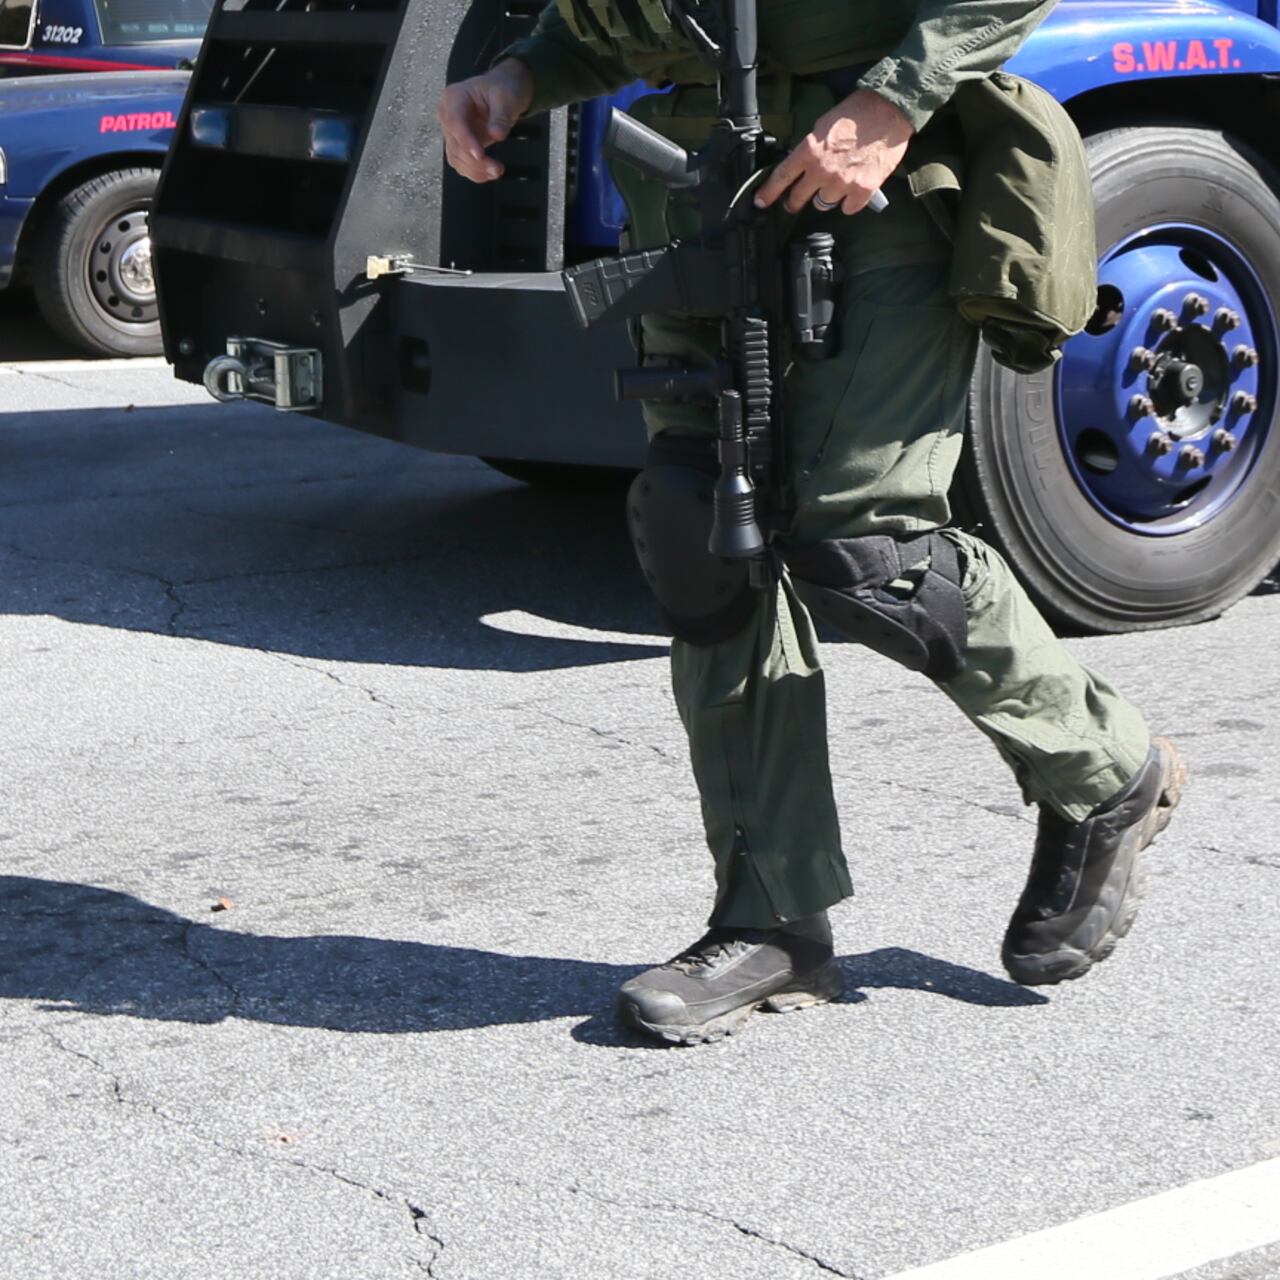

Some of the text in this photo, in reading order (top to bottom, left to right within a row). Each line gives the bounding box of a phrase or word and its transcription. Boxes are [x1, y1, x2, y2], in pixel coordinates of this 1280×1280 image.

[42, 24, 83, 44] 31202
[1112, 38, 1241, 73] S.W.A.T.
[99, 111, 177, 133] PATROL
